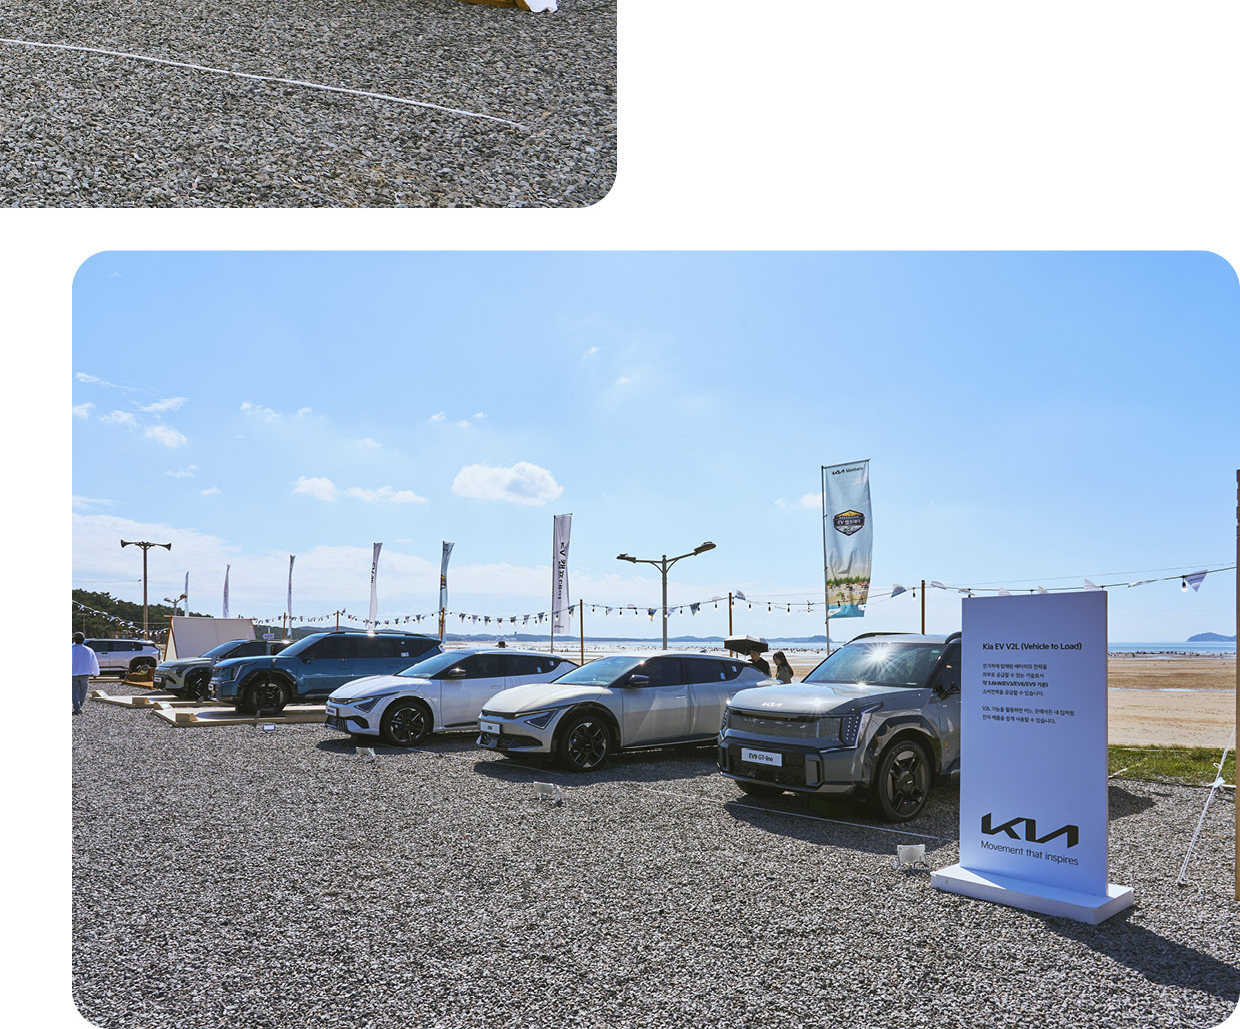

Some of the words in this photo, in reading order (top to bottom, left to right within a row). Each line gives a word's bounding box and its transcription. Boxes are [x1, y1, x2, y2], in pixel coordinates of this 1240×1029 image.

[982, 642, 994, 650] Kia
[1020, 642, 1050, 651] (Vehicle
[1060, 642, 1082, 651] Load)
[748, 752, 758, 760] EV9
[981, 813, 1079, 849] KIA
[980, 840, 1024, 855] Movement
[1026, 849, 1043, 859] that
[1045, 851, 1079, 866] inspires
